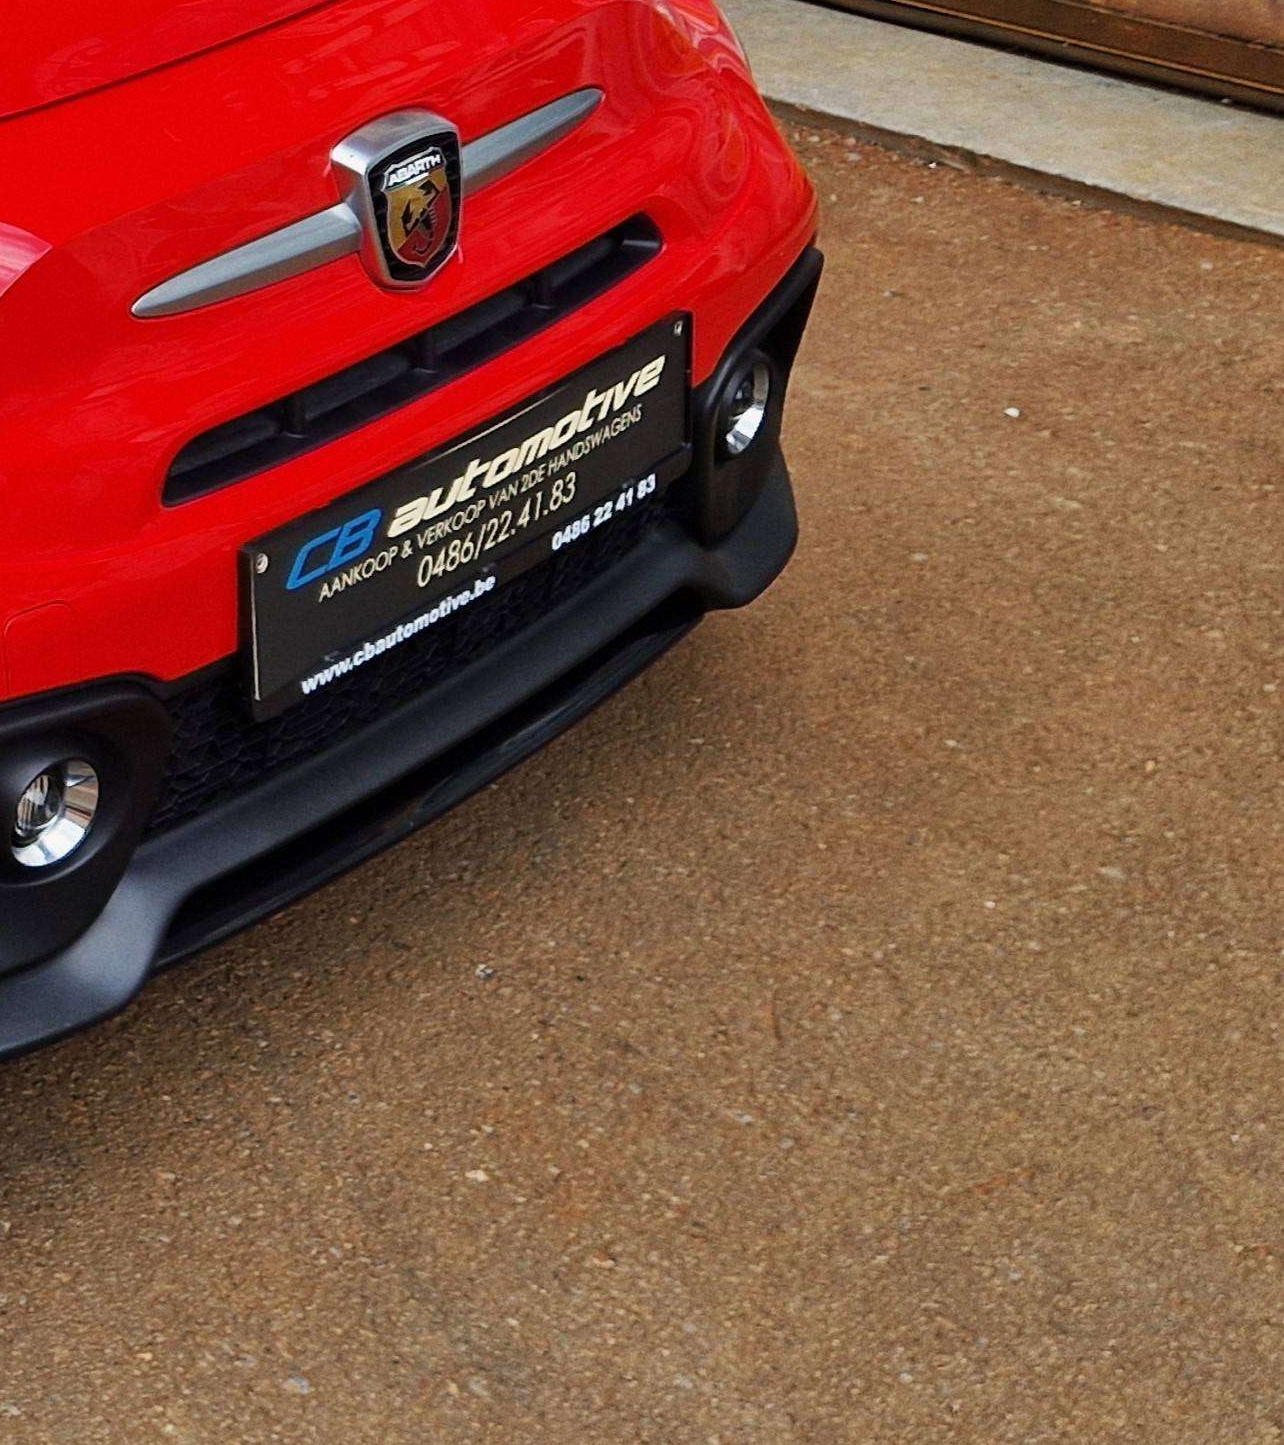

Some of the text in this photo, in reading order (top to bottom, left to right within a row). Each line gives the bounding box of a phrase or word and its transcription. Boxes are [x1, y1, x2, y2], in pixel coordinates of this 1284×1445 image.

[387, 154, 441, 187] ABARTH
[285, 354, 666, 591] CB automotive
[318, 403, 644, 603] AANKOOP & VERKOOP VAN 2DE HANDSWAGENS
[416, 471, 577, 588] 0486/22.41.83
[551, 472, 657, 551] 0486 22 41 83
[300, 575, 497, 695] www.cbautomotive.be
